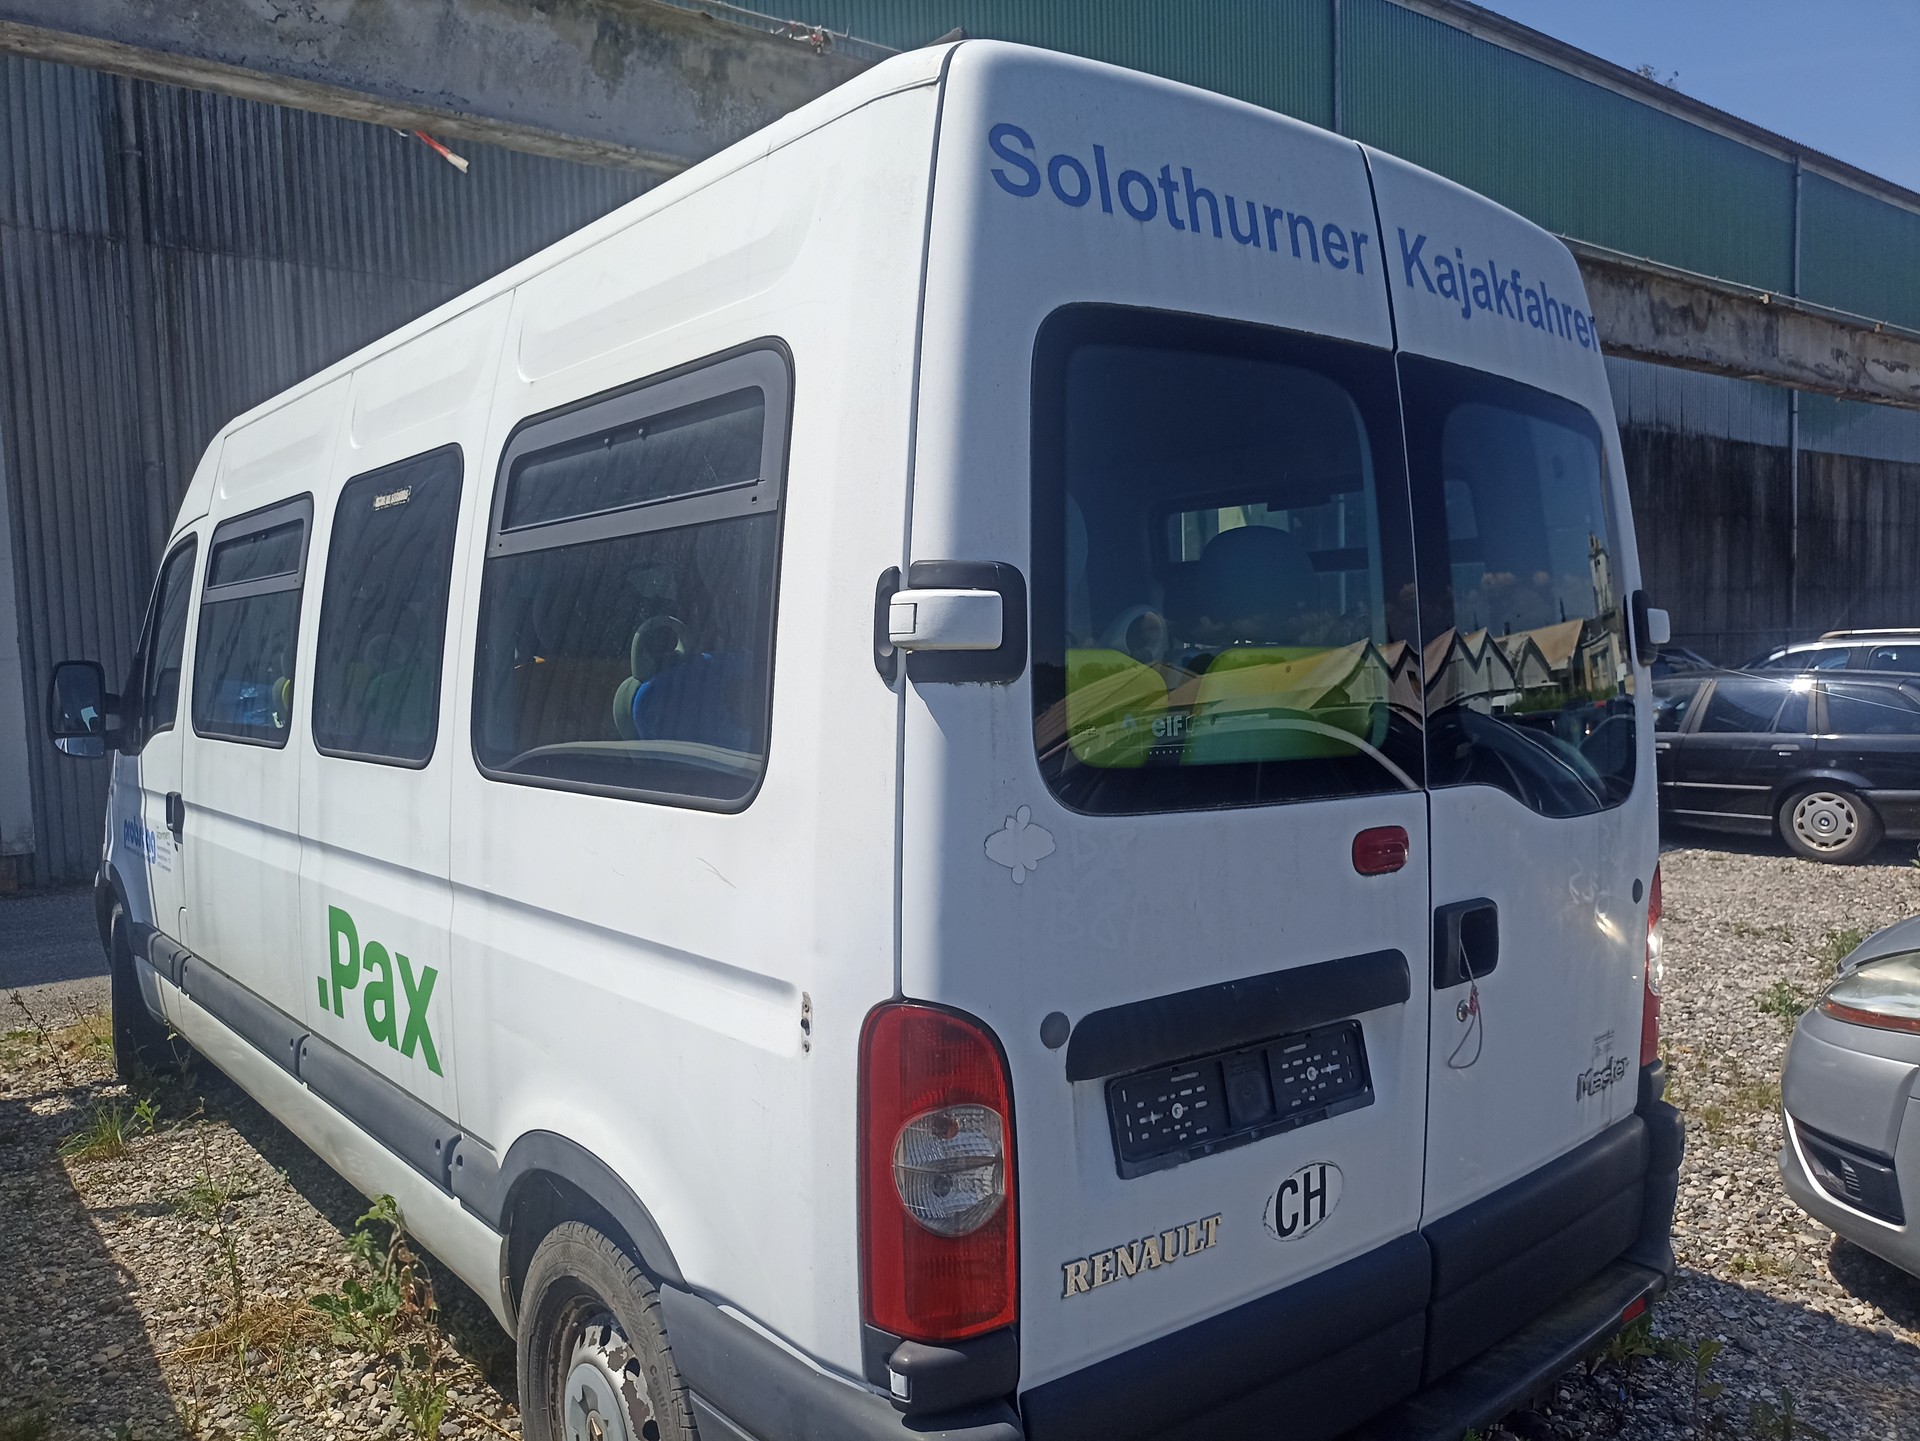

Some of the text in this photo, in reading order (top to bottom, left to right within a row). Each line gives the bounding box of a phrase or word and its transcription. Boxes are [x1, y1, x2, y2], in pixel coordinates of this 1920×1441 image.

[988, 122, 1598, 353] Solothurner Kajakfahrer
[1151, 715, 1183, 737] elf
[317, 904, 444, 1079] .Pax
[1576, 1056, 1629, 1101] Master
[1275, 1164, 1327, 1238] CH
[1060, 1212, 1223, 1300] RENAULT
